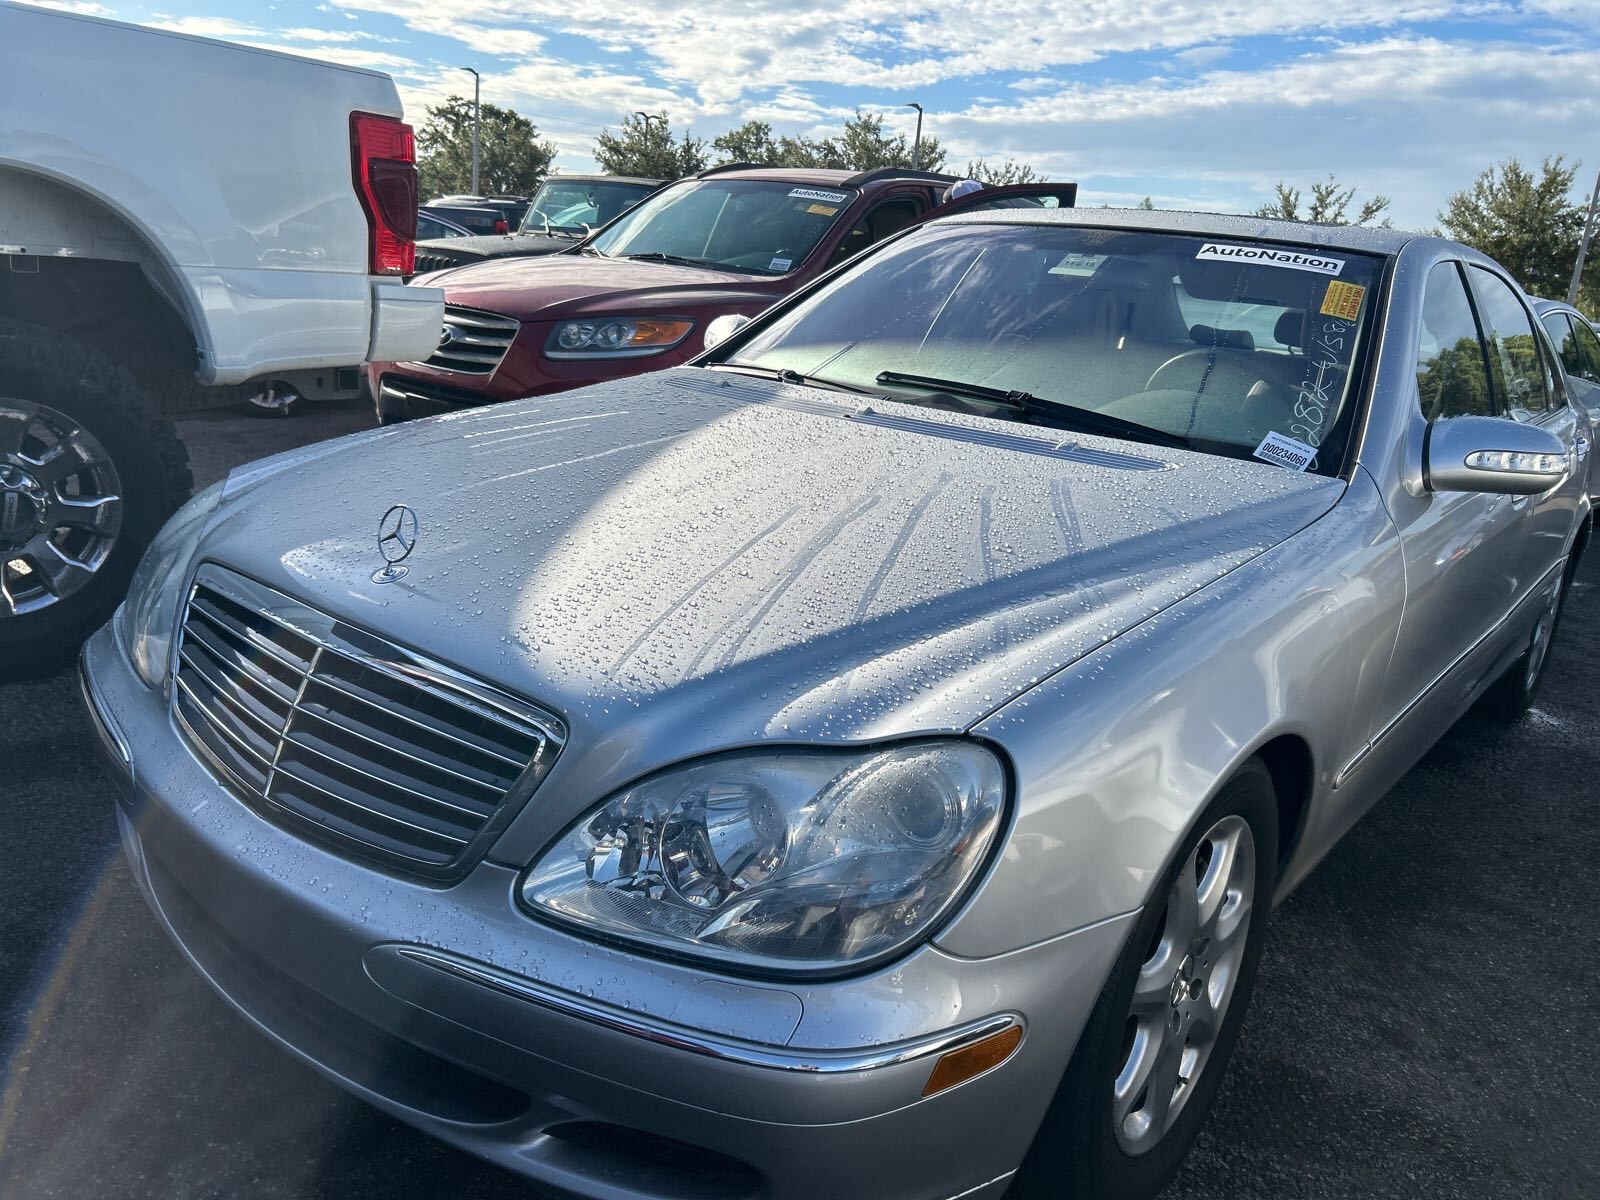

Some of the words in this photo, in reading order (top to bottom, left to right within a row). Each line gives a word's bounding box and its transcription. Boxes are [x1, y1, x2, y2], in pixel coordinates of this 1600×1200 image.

[792, 189, 843, 201] AutoNation
[1201, 245, 1338, 270] AutoNation
[1272, 436, 1303, 450] AUTONATION
[1262, 442, 1307, 466] 000234060
